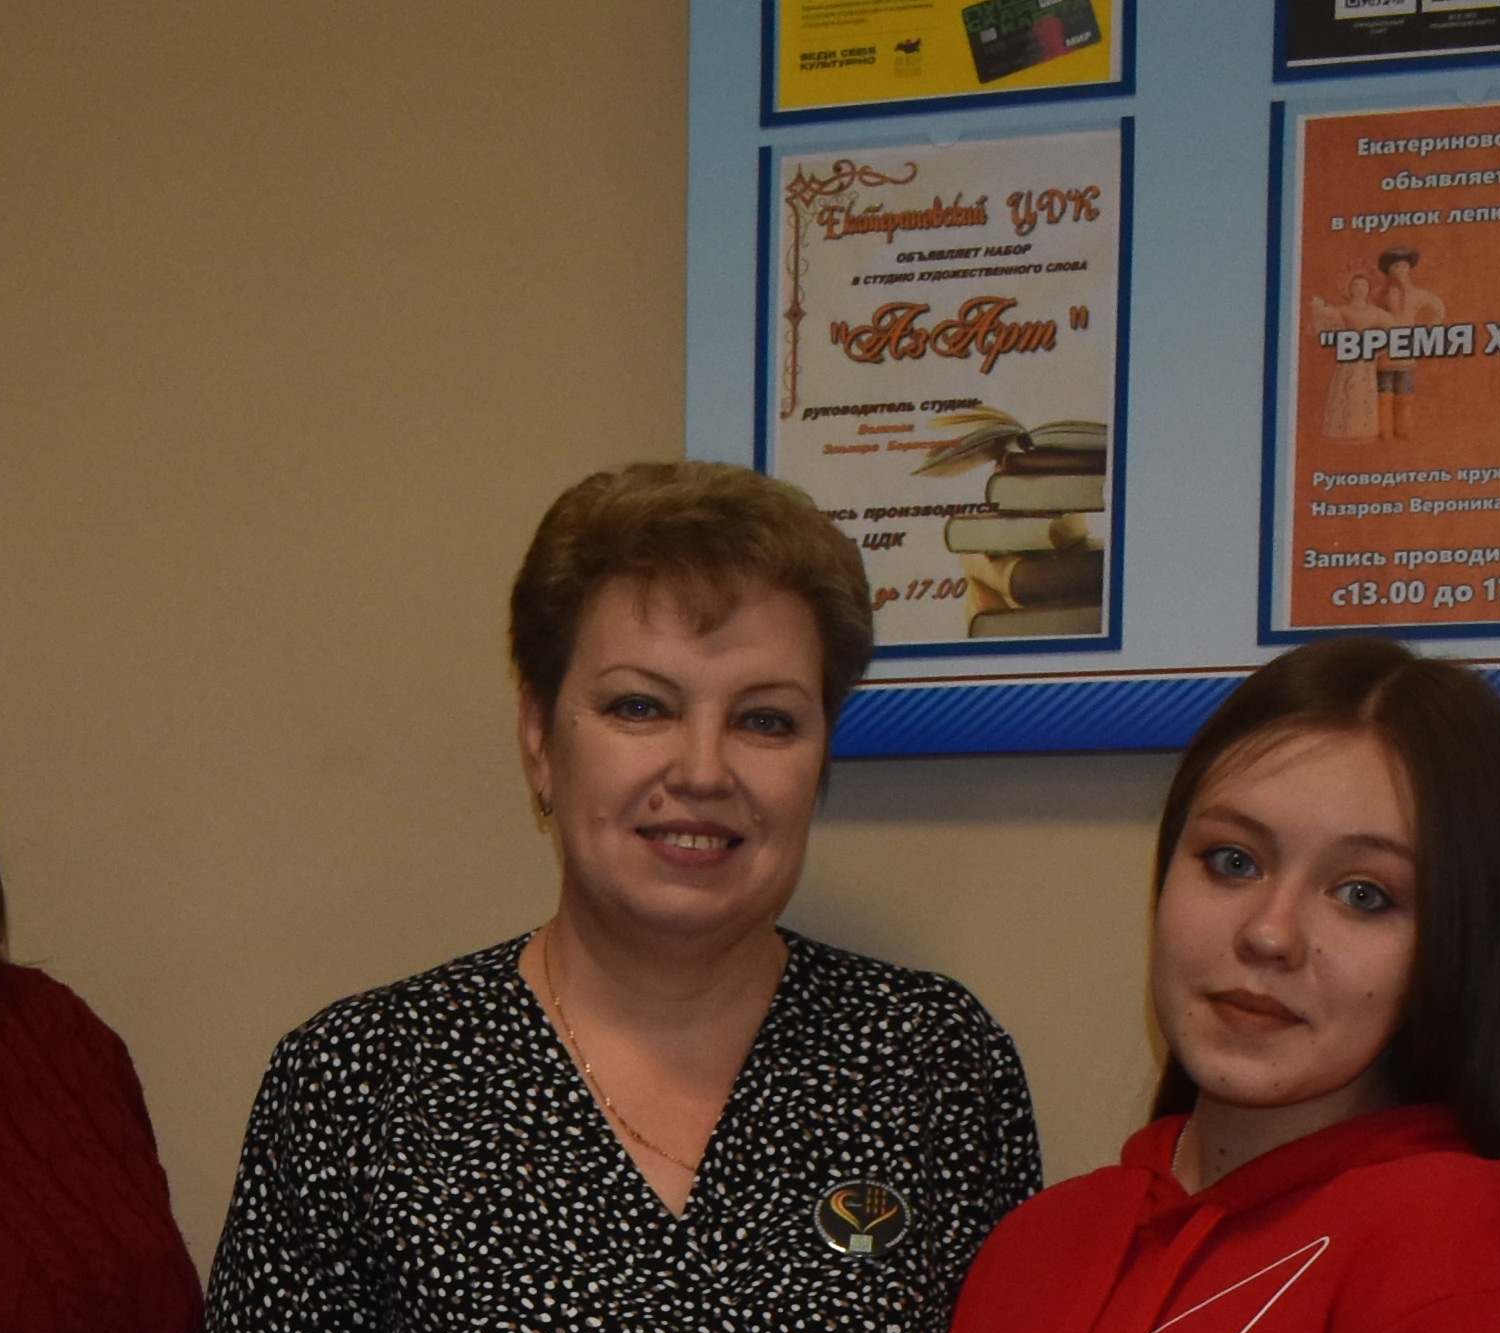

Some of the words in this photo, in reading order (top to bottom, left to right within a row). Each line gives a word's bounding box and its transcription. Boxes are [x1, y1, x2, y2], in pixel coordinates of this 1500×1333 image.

[1006, 185, 1101, 237] ЦДК
[1331, 216, 1345, 231] в
[1351, 211, 1441, 234] кружок
[896, 247, 982, 264] ОБЪЯВЛЯЕТ
[983, 243, 1033, 259] НАБОР
[863, 272, 915, 287] СТУДИЮ
[916, 262, 1043, 283] ХУДОЖЕСТВЕННОГО
[1045, 260, 1088, 273] СЛОВА
[1319, 323, 1475, 363] "ВРЕМЯ
[802, 401, 916, 421] руководитель
[1312, 469, 1452, 491] Руководитель
[1311, 500, 1404, 519] Назарова
[863, 531, 907, 551] ЦДК
[1304, 548, 1388, 569] Запись
[904, 576, 970, 600] 17.00
[1432, 584, 1474, 608] до
